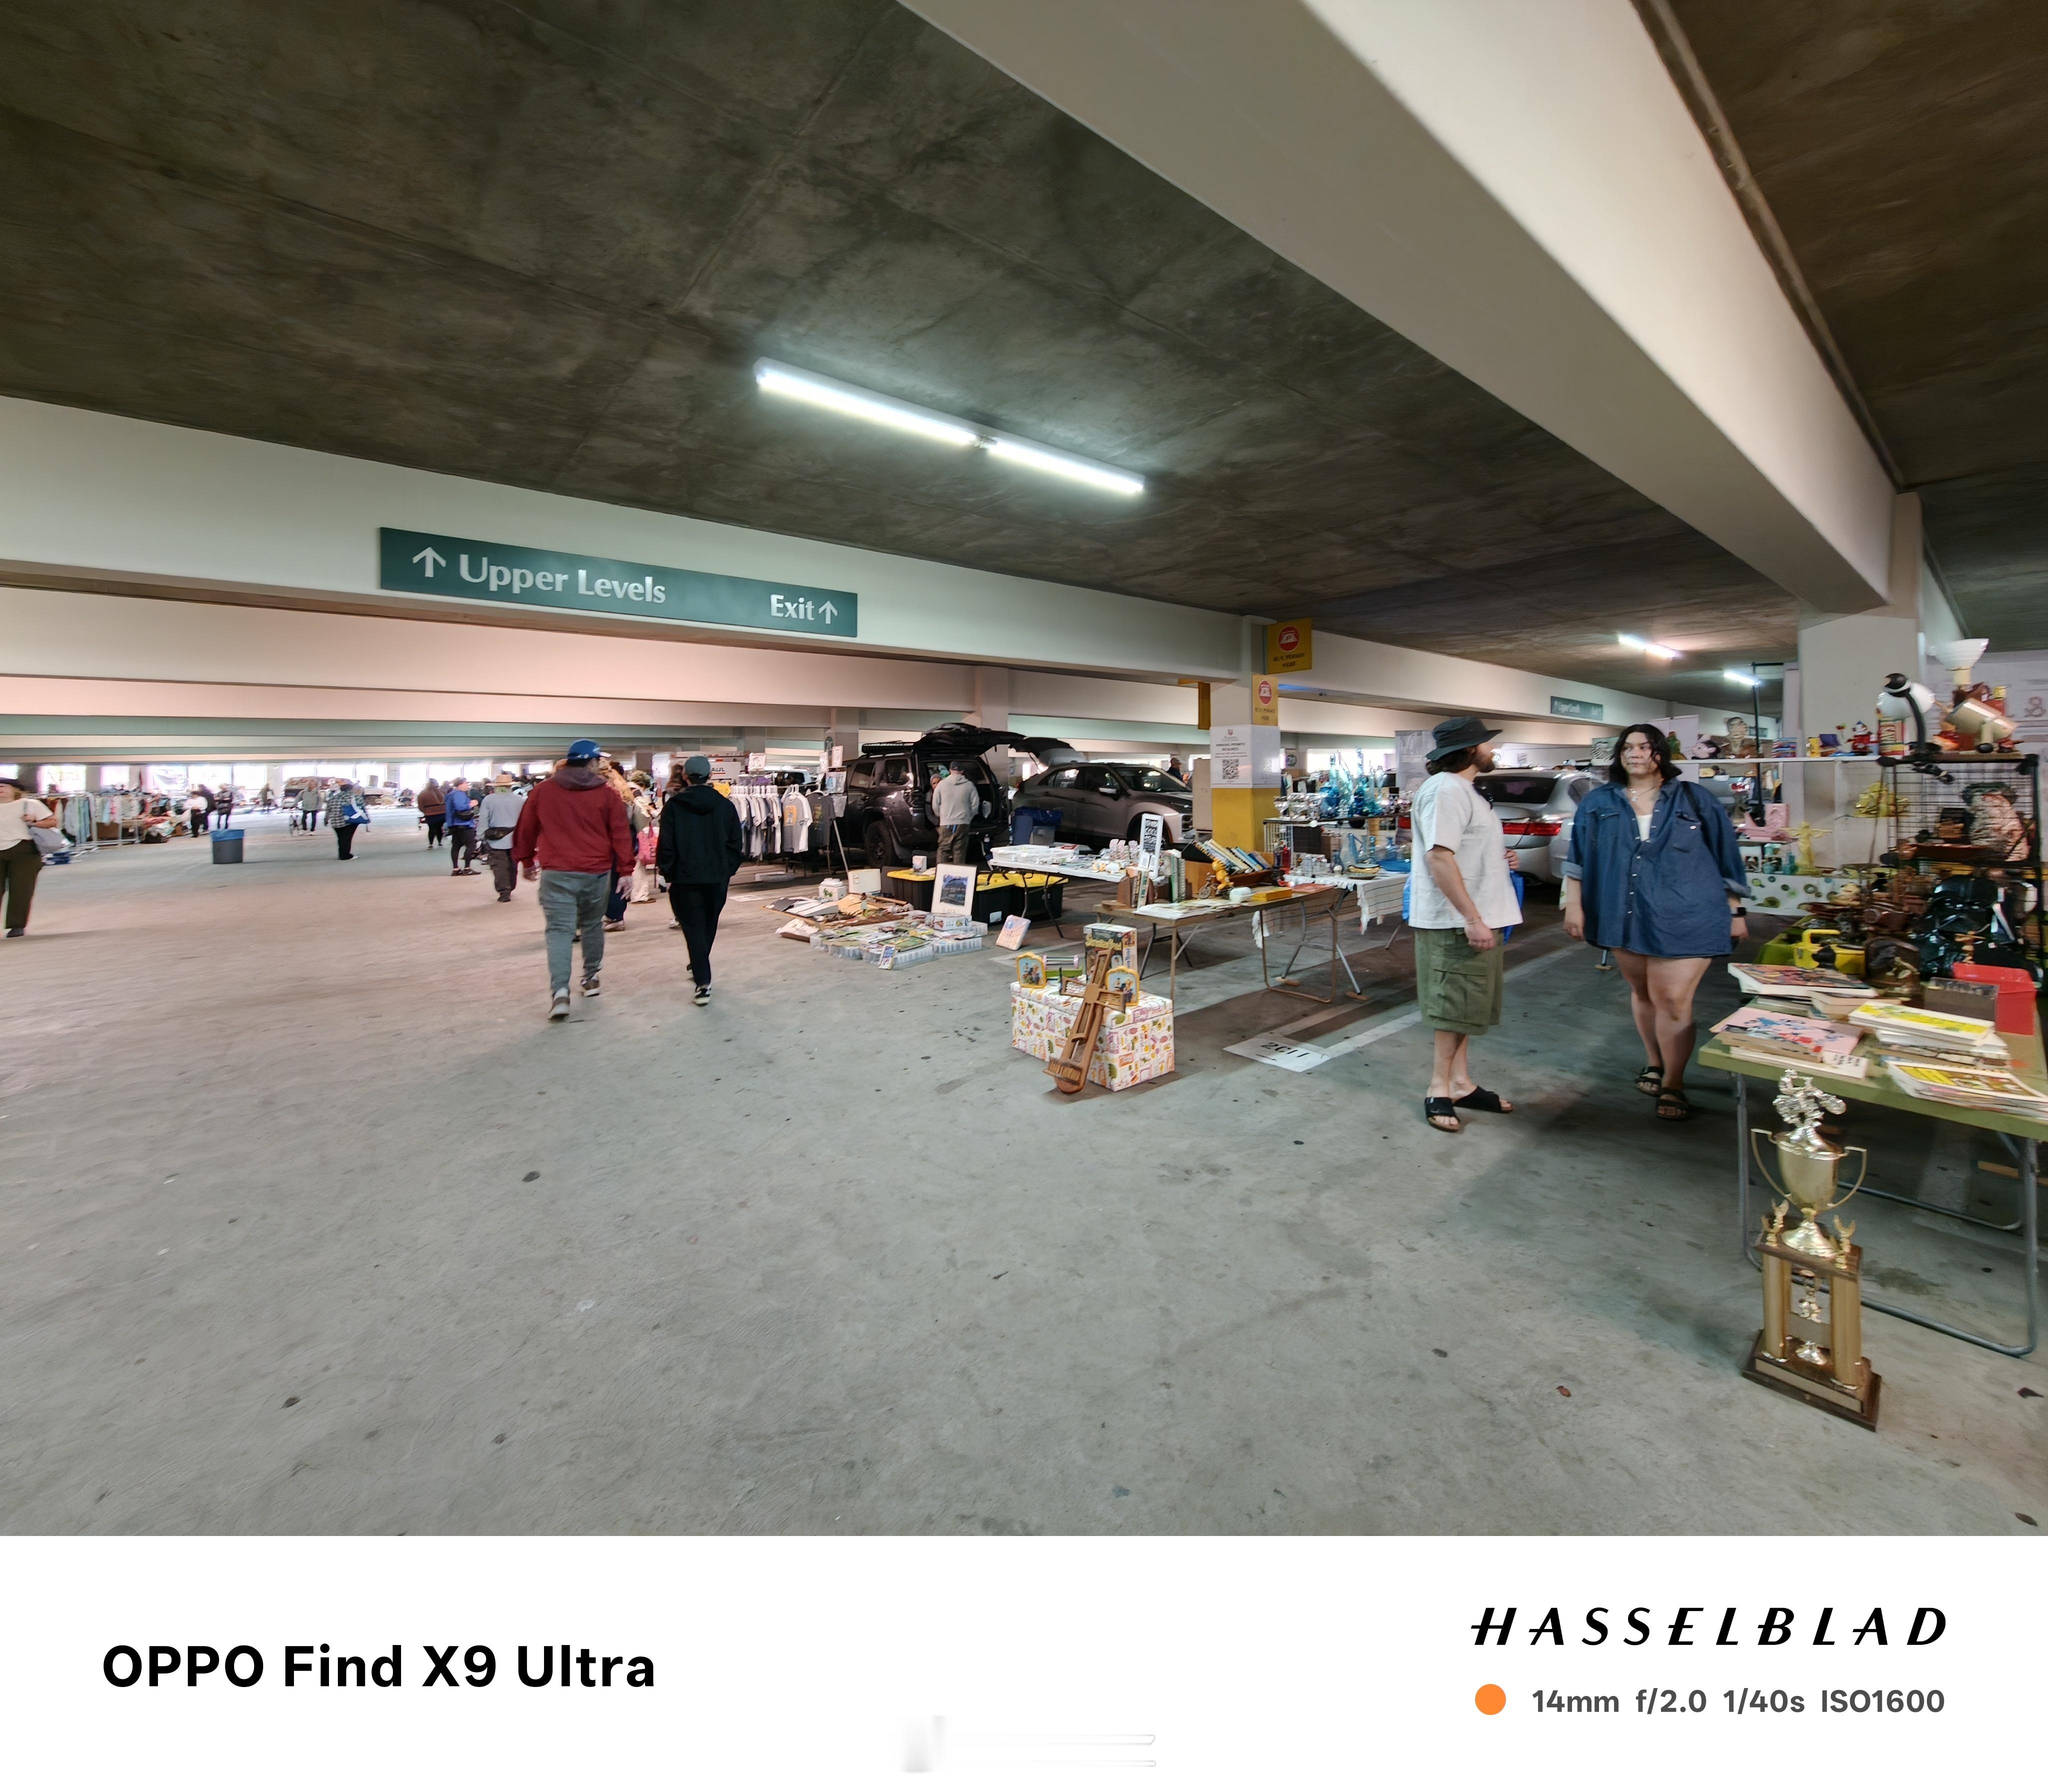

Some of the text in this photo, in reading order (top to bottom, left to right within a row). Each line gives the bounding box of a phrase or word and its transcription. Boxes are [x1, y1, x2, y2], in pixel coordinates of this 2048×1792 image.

[460, 554, 814, 620] Upper Levels Exit
